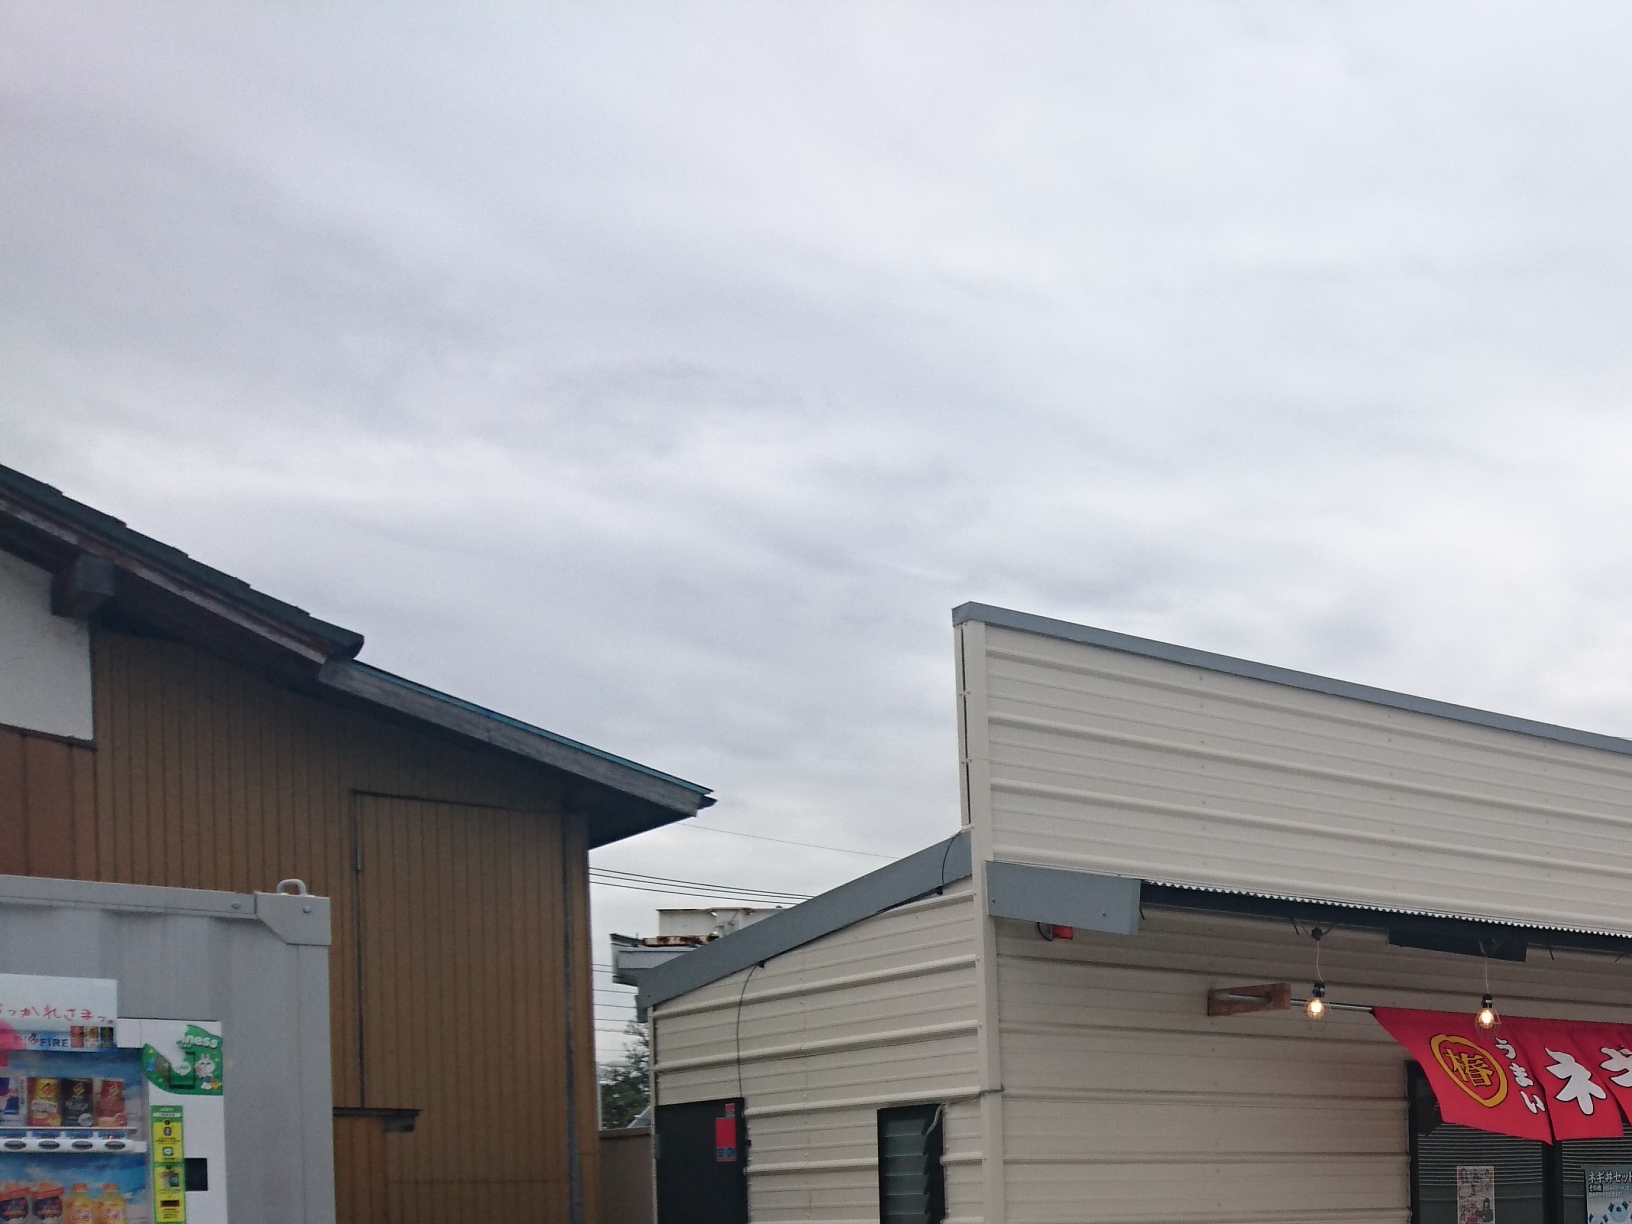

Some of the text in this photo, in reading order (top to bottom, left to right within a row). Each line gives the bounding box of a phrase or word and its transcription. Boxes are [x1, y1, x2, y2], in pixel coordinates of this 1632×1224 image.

[40, 1038, 69, 1048] FIRE
[1446, 1047, 1494, 1088] 椿
[1494, 1037, 1546, 1114] うまい
